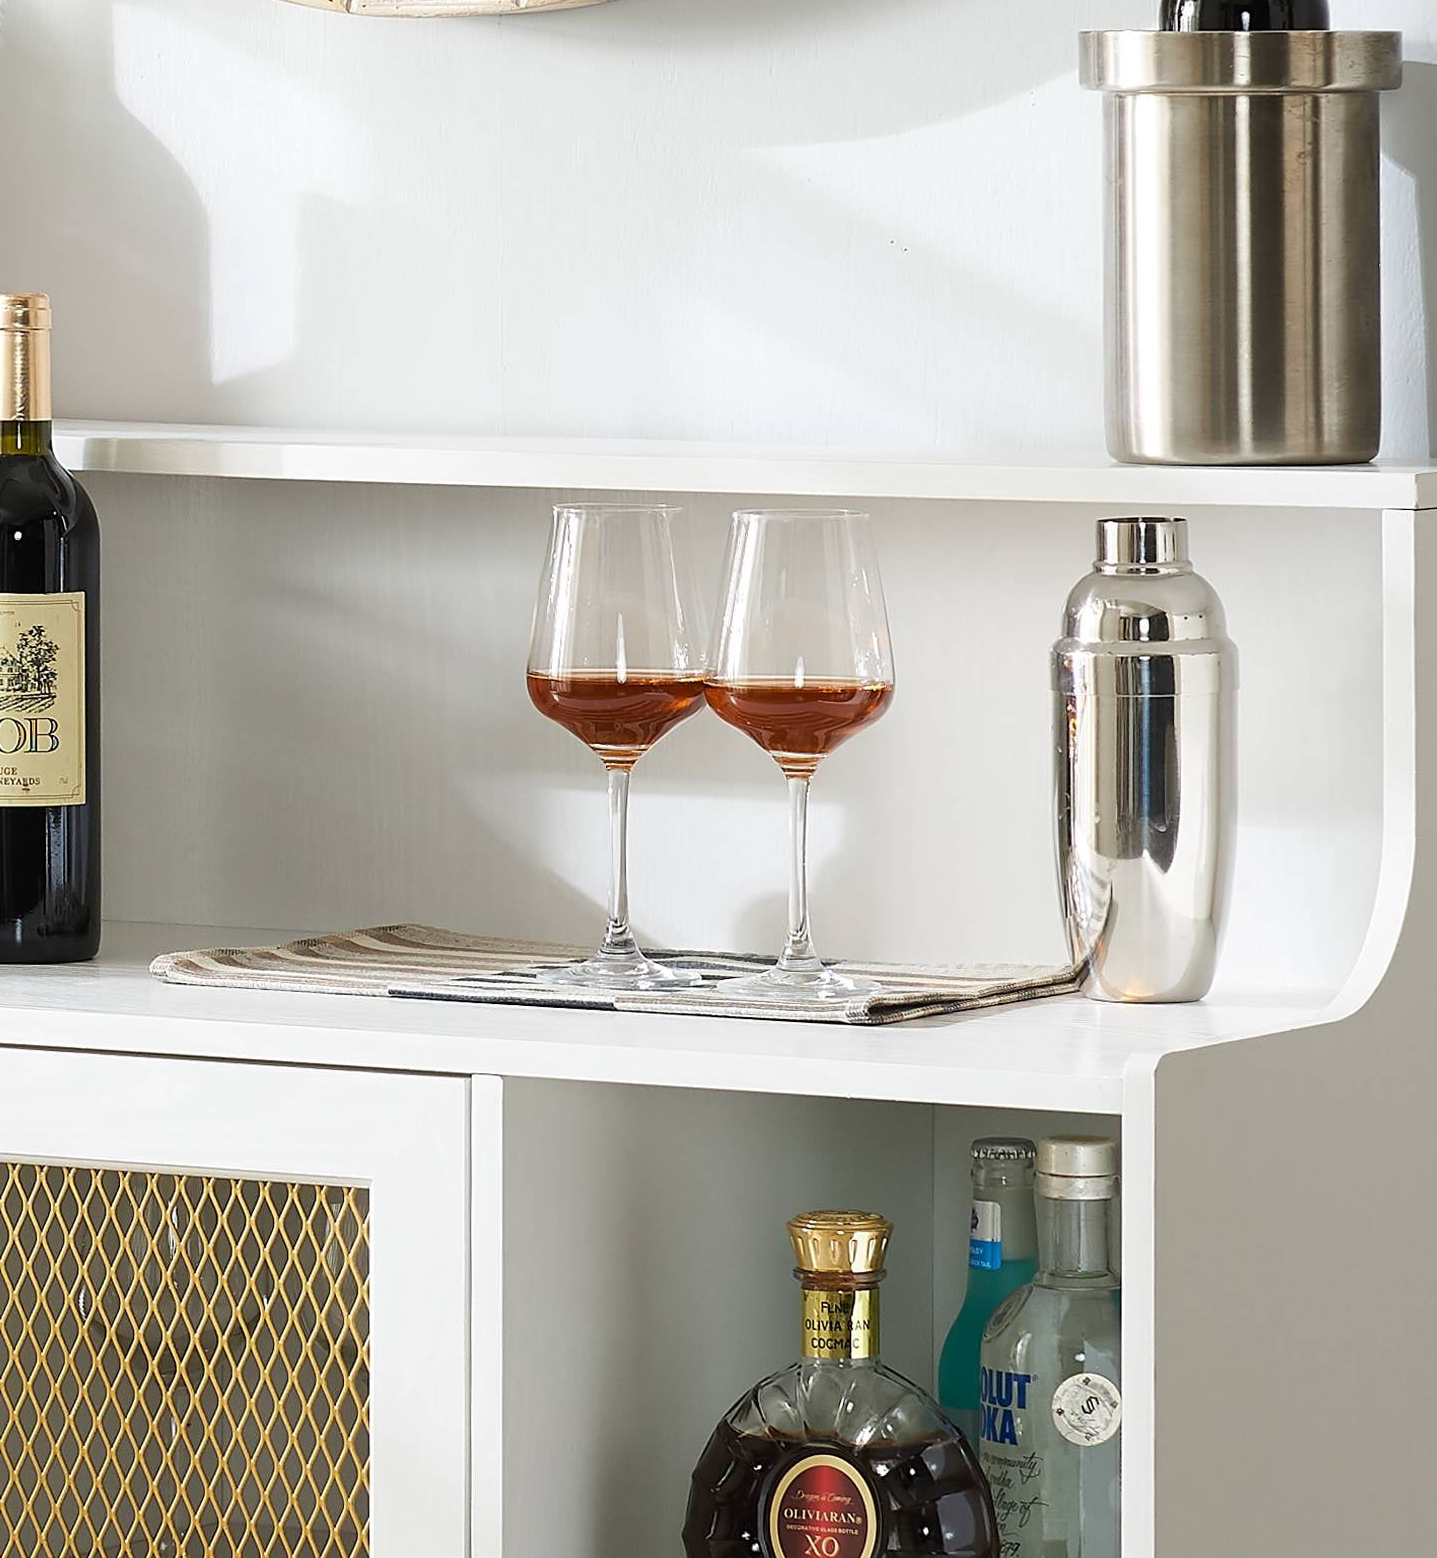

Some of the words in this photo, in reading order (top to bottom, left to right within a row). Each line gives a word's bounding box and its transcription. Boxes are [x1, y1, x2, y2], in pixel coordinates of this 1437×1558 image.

[805, 1318, 843, 1332] OLIVIA
[847, 1319, 871, 1332] RAN
[982, 1366, 1031, 1409] OLUT
[982, 1403, 1018, 1446] DKA
[804, 1534, 840, 1557] XO
